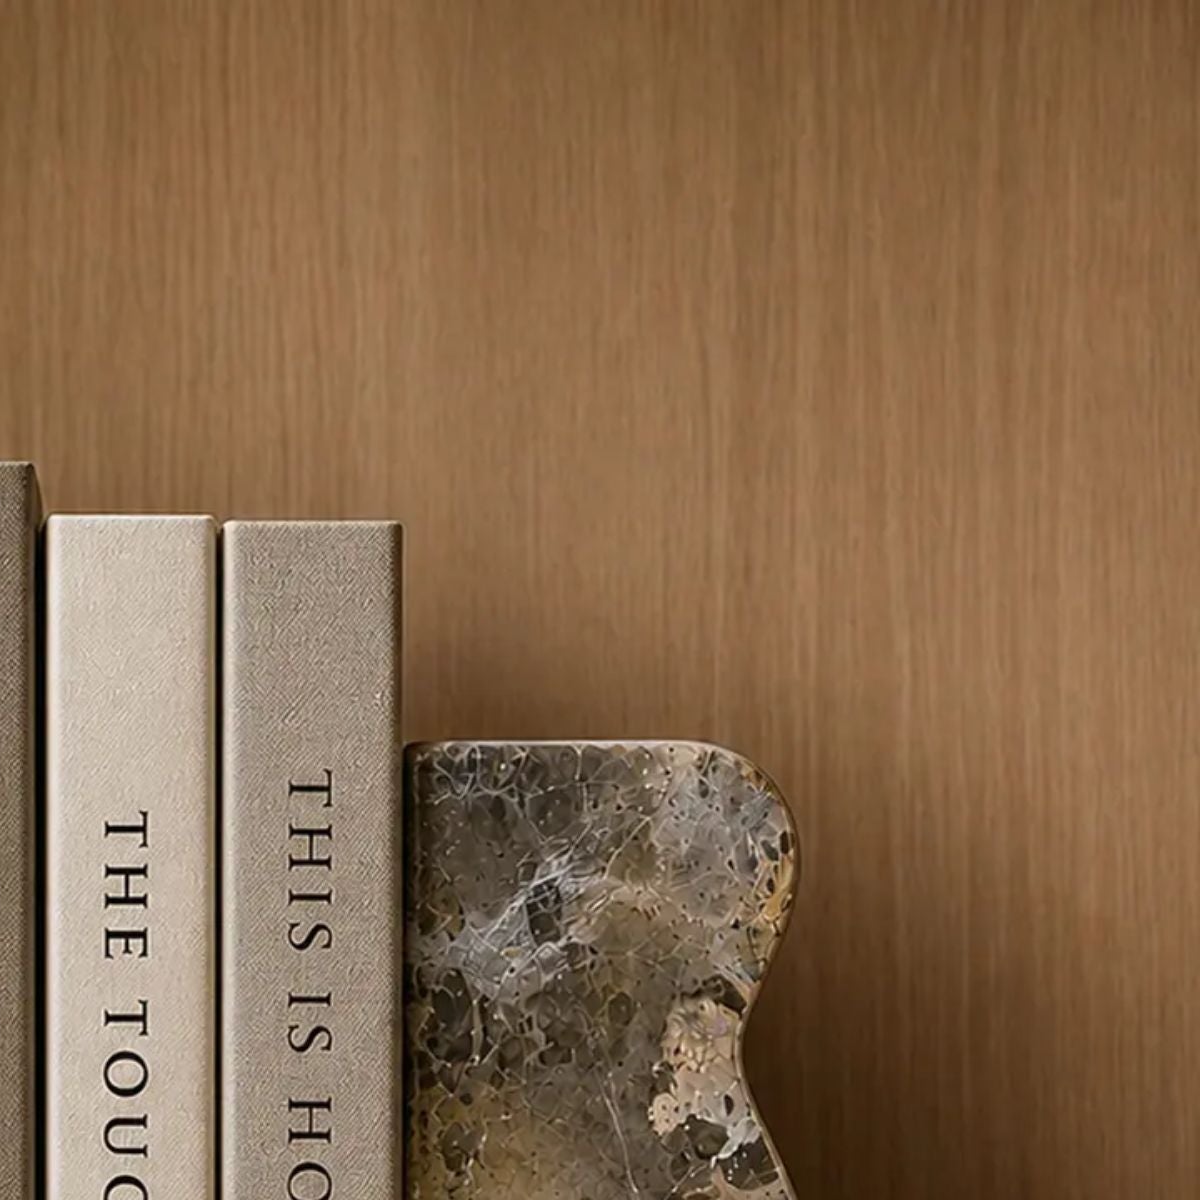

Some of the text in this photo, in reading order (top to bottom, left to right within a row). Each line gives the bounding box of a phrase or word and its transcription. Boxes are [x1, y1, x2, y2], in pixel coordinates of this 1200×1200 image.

[104, 810, 148, 959] THE
[288, 769, 333, 951] THIS
[287, 992, 333, 1053] IS
